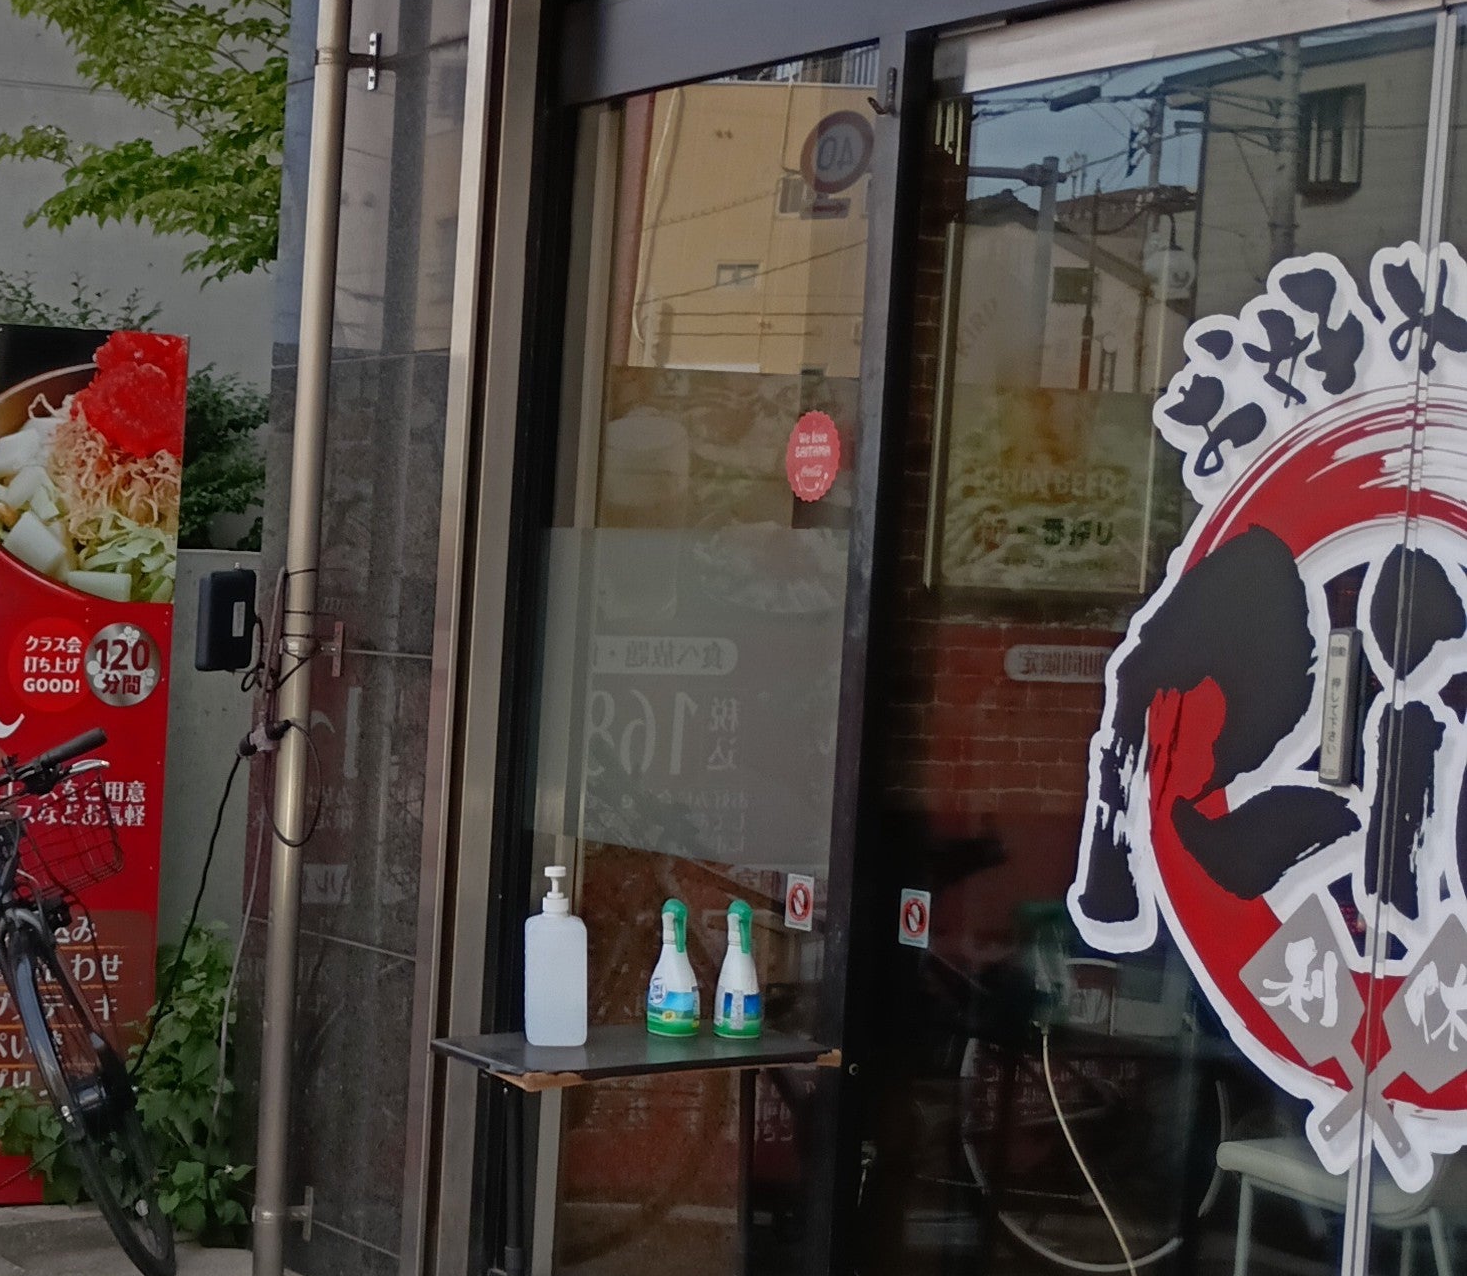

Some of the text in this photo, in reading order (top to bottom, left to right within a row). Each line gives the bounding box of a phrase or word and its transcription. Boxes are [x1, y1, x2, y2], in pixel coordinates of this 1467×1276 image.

[23, 635, 82, 655] クラス会
[99, 637, 151, 672] 120
[22, 655, 80, 676] 打ち上げ
[22, 677, 81, 695] GOOD!
[101, 673, 142, 697] 分間
